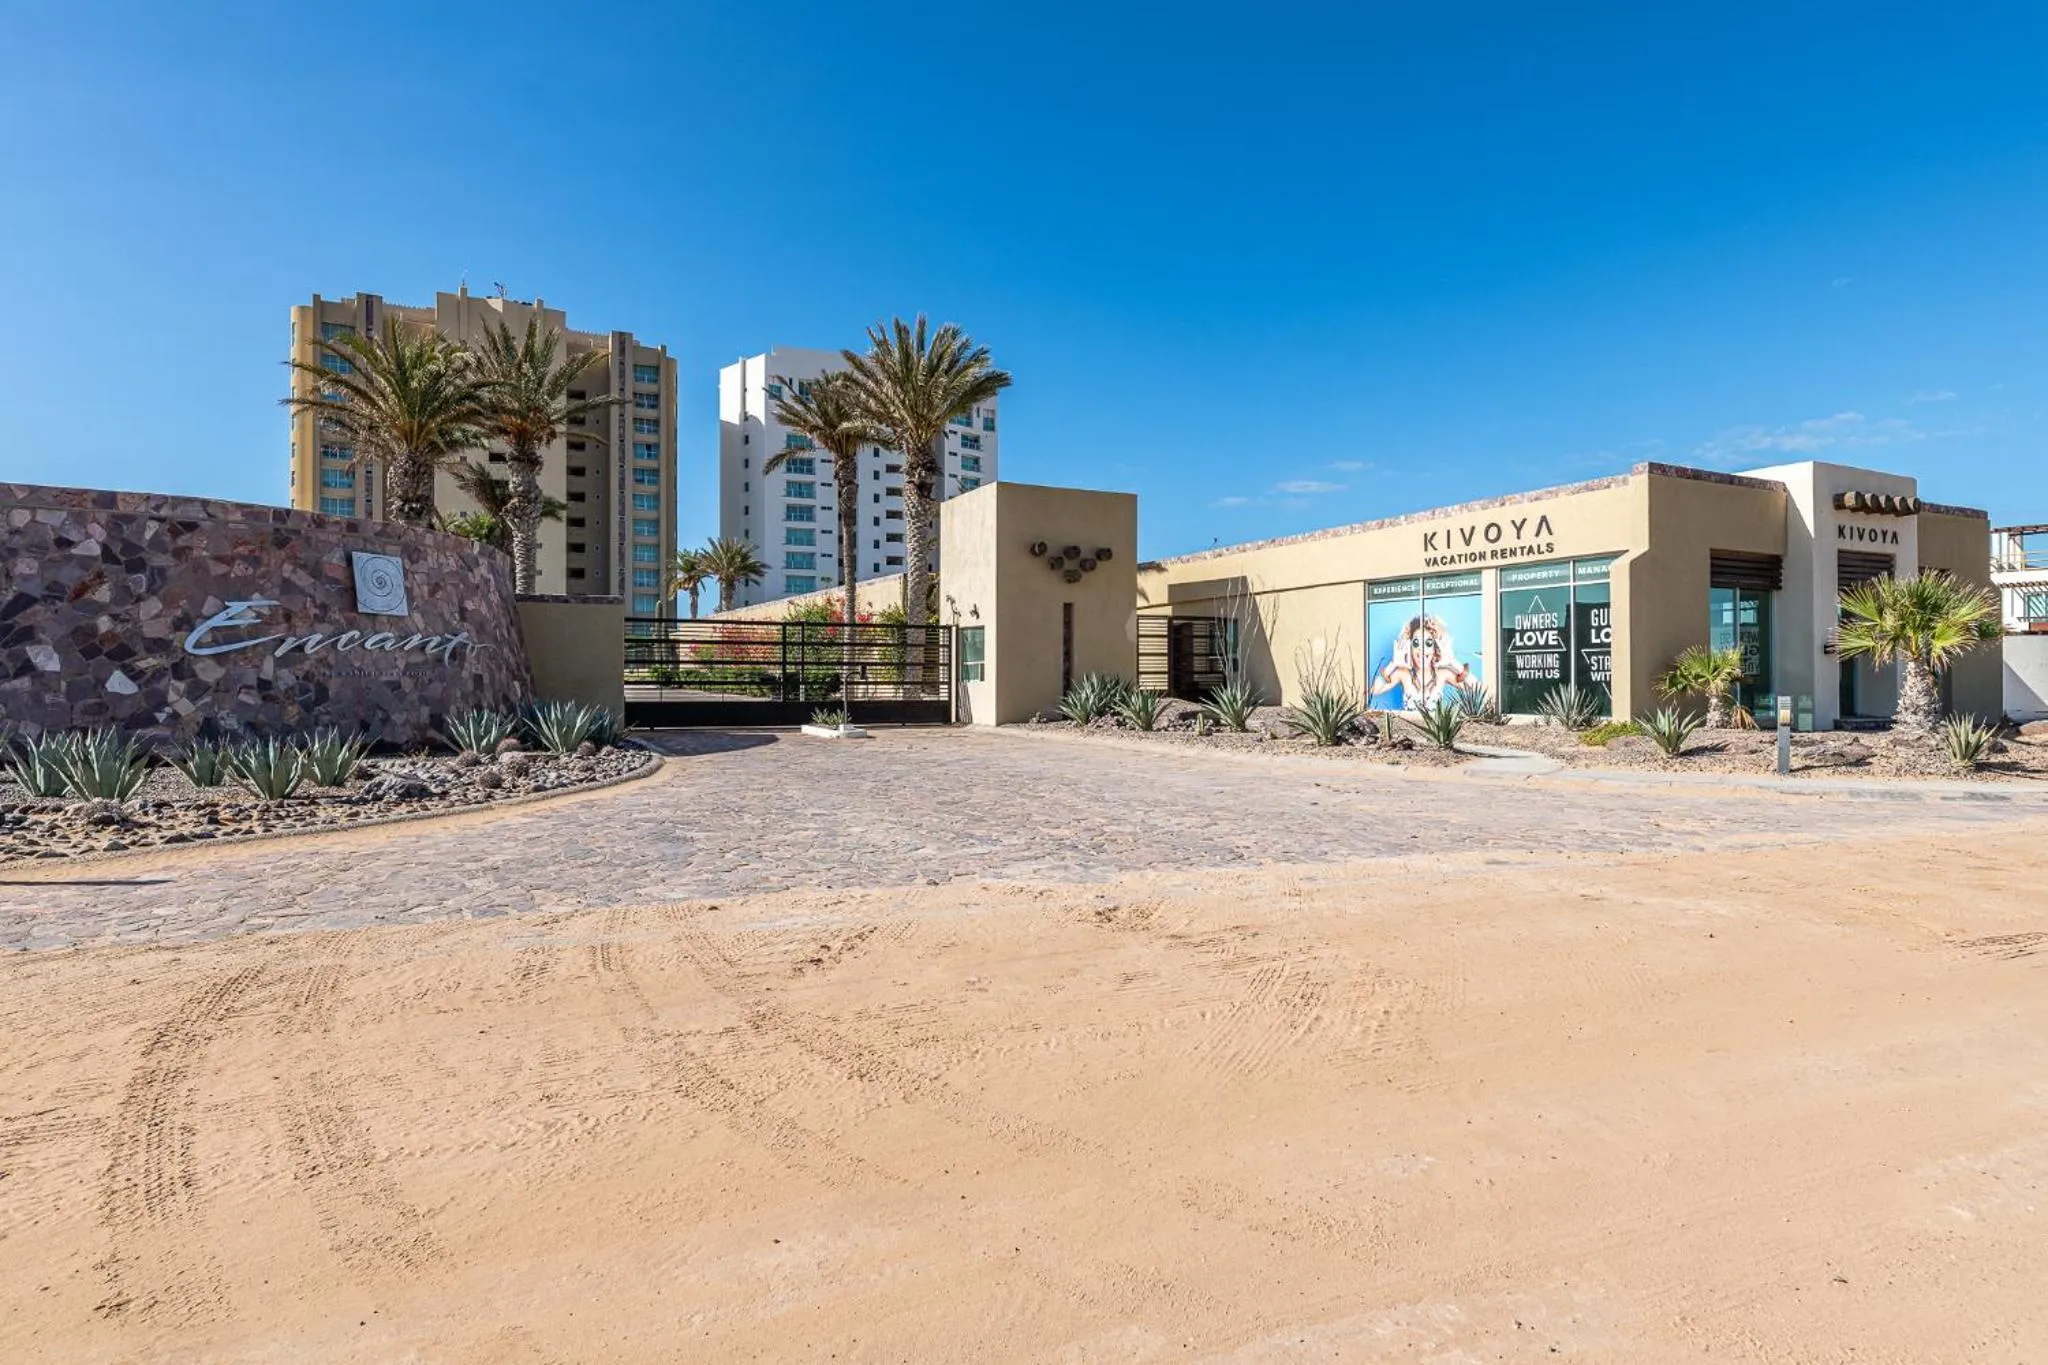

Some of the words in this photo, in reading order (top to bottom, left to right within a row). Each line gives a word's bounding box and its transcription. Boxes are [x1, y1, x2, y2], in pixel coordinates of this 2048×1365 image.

[1423, 515, 1553, 552] KIVOYA
[1838, 524, 1898, 544] KIVOYA
[1424, 551, 1487, 567] VACATION
[1490, 542, 1554, 560] RENTALS
[1512, 570, 1560, 582] PROPERTY
[1373, 585, 1417, 594] EXPERIENCE
[1426, 578, 1479, 590] EXCEPTIONAL
[1515, 613, 1558, 630] OWNERS
[184, 600, 496, 667] Encanto
[1515, 630, 1558, 646] LOVE
[1515, 654, 1560, 669] WORKING
[1516, 670, 1542, 679] WITH
[1545, 668, 1560, 679] US
